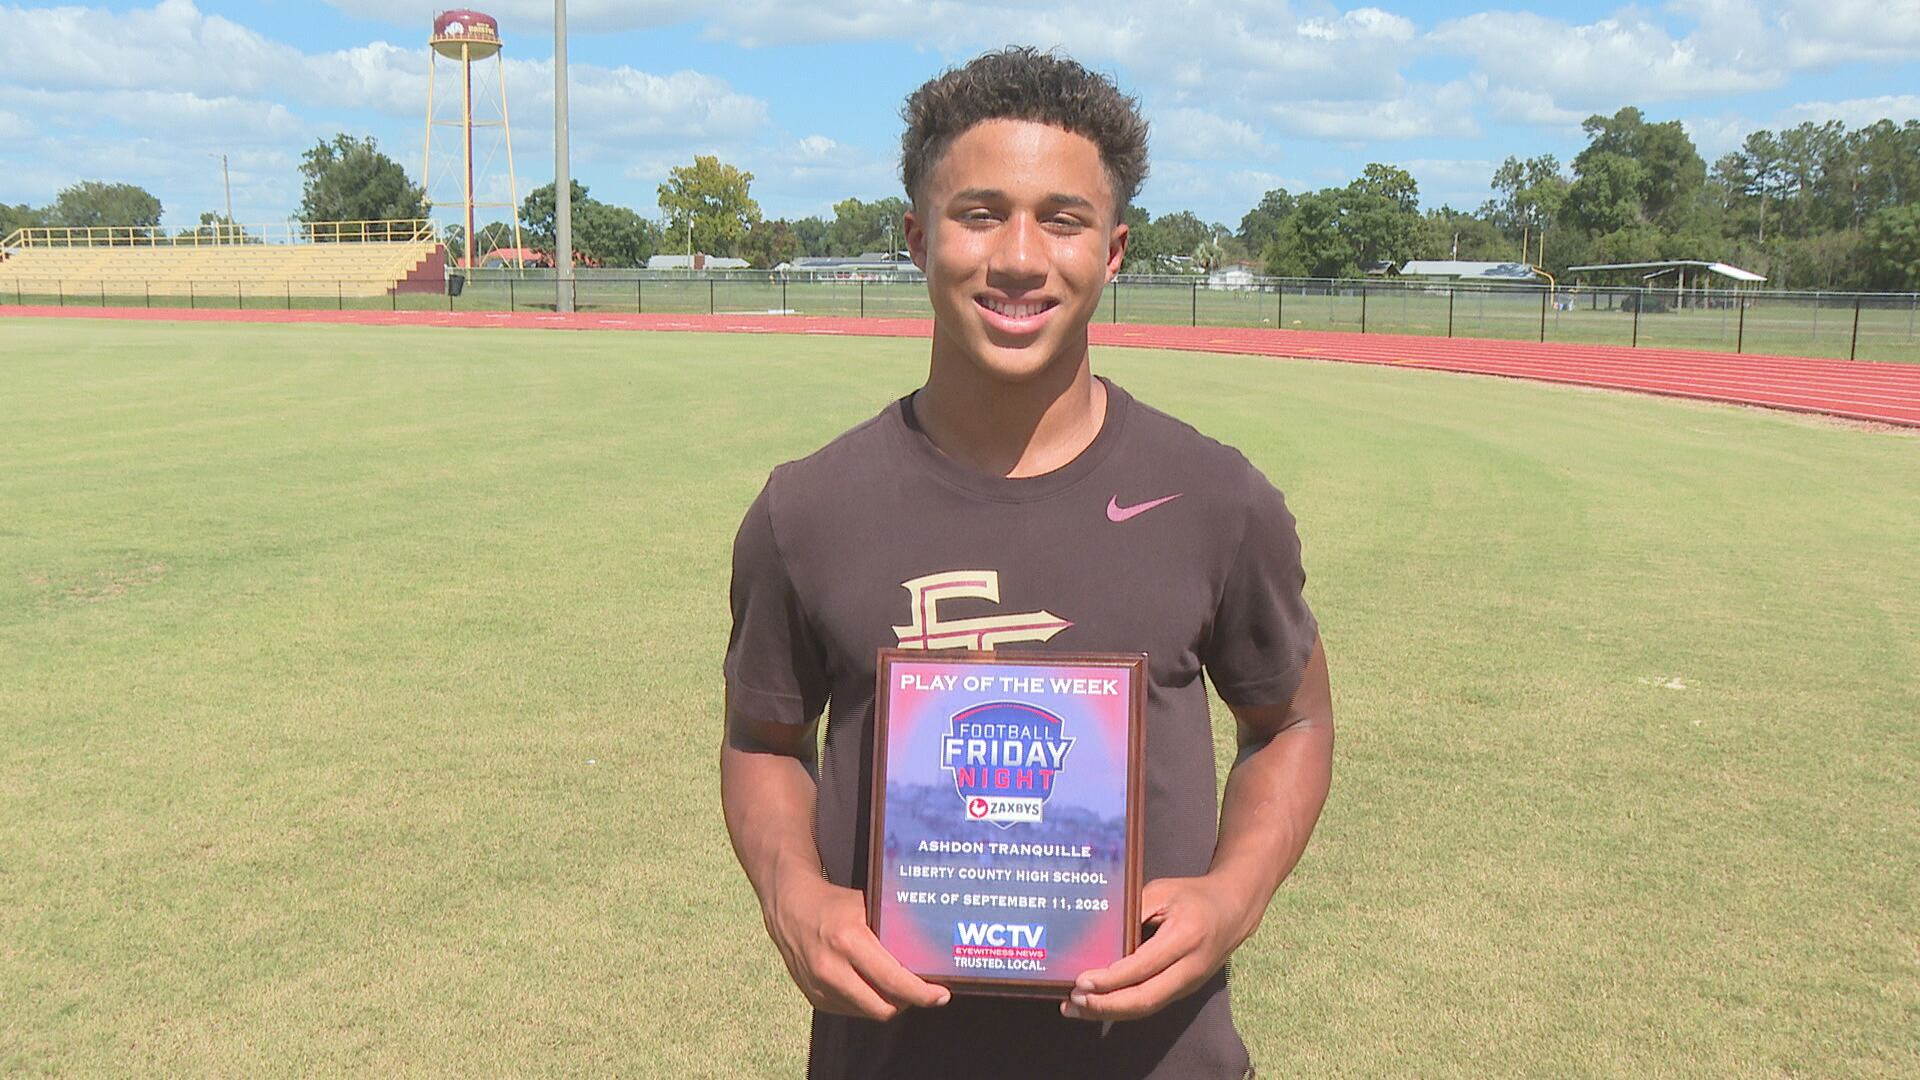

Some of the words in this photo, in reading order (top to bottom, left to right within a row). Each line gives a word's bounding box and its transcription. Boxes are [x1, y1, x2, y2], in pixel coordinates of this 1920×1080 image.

[900, 674, 958, 691] PLAY
[963, 675, 994, 692] OF
[998, 676, 1045, 694] THE
[1049, 678, 1119, 696] WEEK
[960, 723, 1054, 740] FOOTBALL
[946, 739, 1068, 768] FRIDAY
[958, 768, 1056, 790] NIGHT
[990, 802, 1039, 815] ZAXBYS
[918, 840, 984, 854] ASHDON
[988, 843, 1092, 858] TRANQUILLE
[899, 865, 954, 879] LIBERTY
[958, 868, 1012, 882] COUNTY
[1016, 870, 1049, 883] HIGH
[1053, 871, 1108, 885] SCHOOL
[897, 891, 936, 904] WEEK
[940, 893, 959, 904] OF
[963, 894, 1047, 909] SEPTEMBER
[1052, 899, 1072, 911] 11,
[1075, 898, 1109, 911] 2026
[957, 922, 1044, 948] WCTV
[955, 947, 1014, 956] EYEWITNESS
[1016, 949, 1043, 958] NEWS
[954, 957, 1006, 969] TRUSTED.
[1007, 959, 1046, 971] LOCAL.
